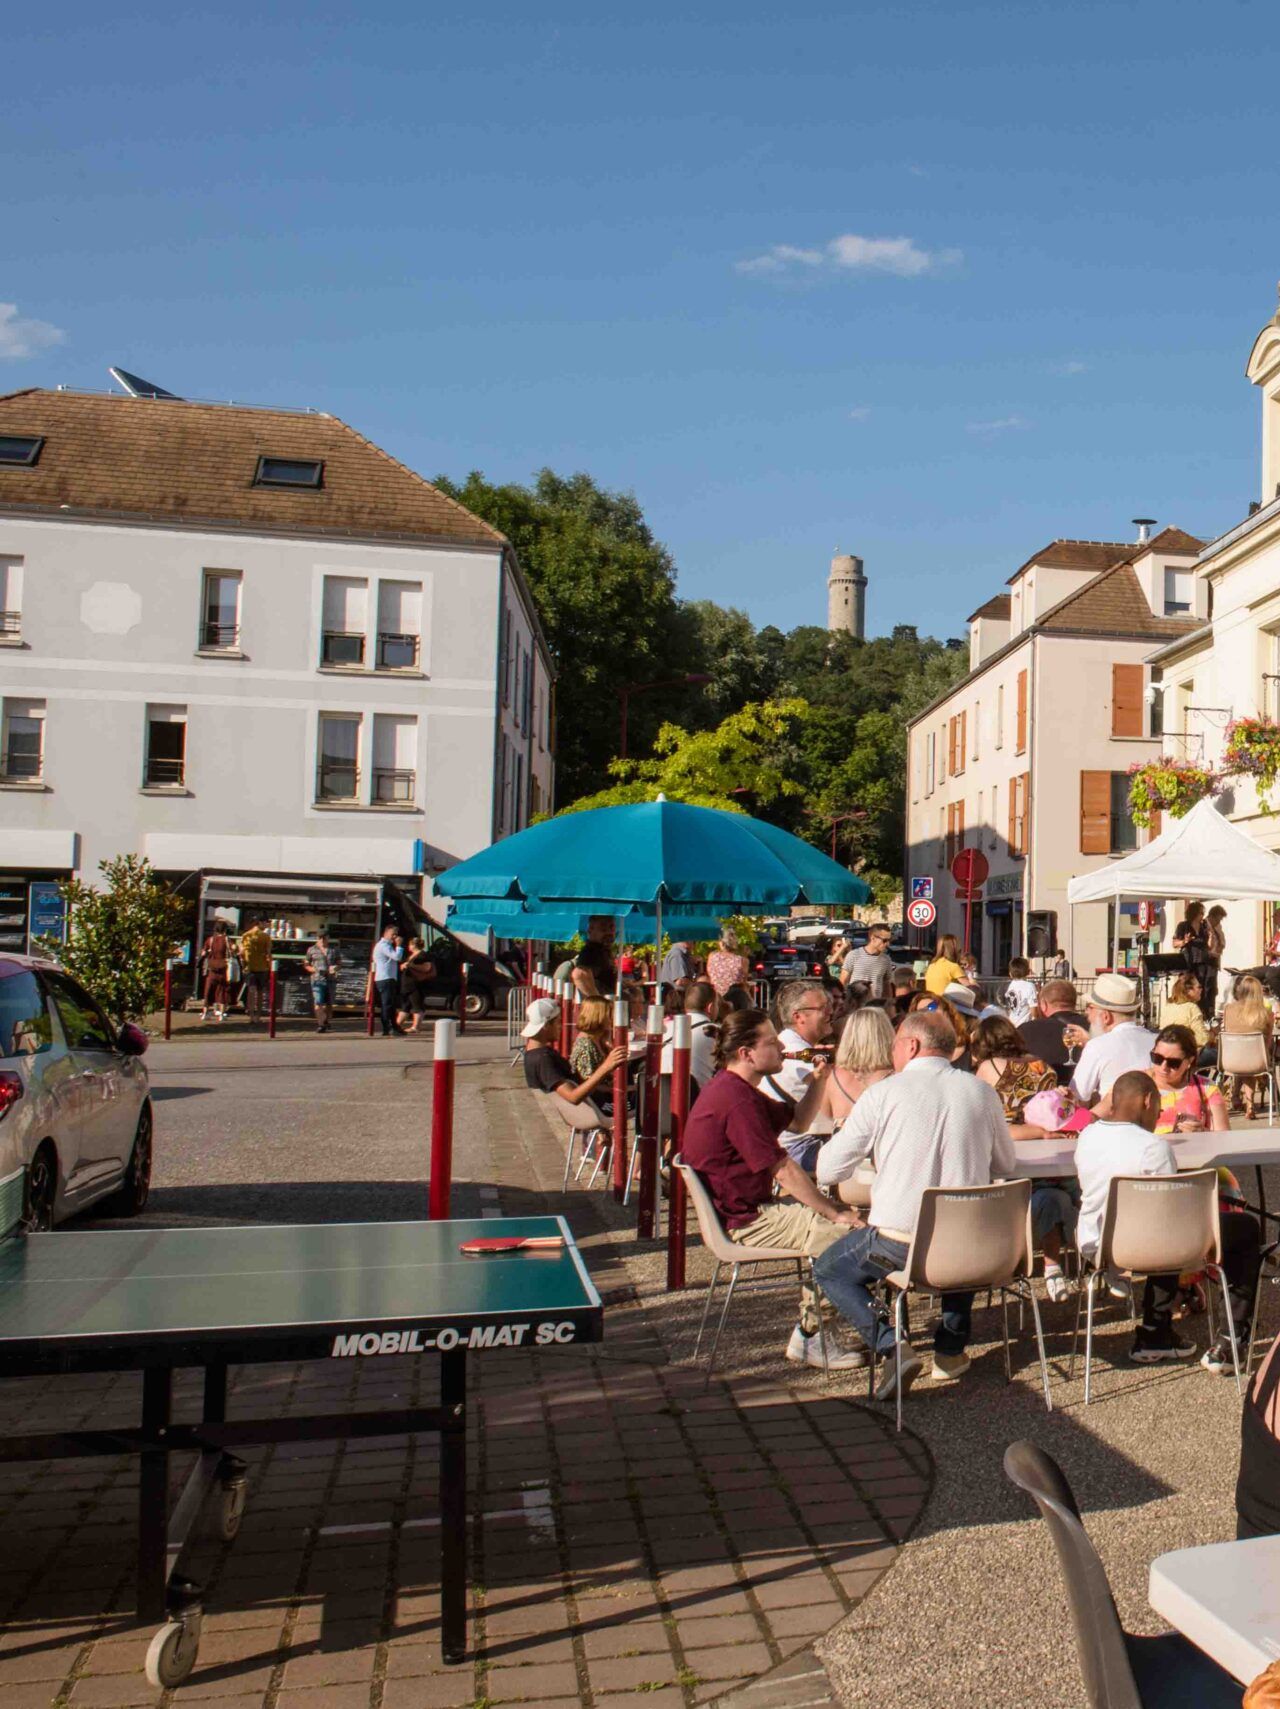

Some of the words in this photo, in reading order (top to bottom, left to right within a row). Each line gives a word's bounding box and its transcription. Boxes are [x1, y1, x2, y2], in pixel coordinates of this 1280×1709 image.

[914, 907, 929, 918] 30
[331, 1323, 530, 1358] MOBIL-O-MAT
[535, 1321, 576, 1345] SC
